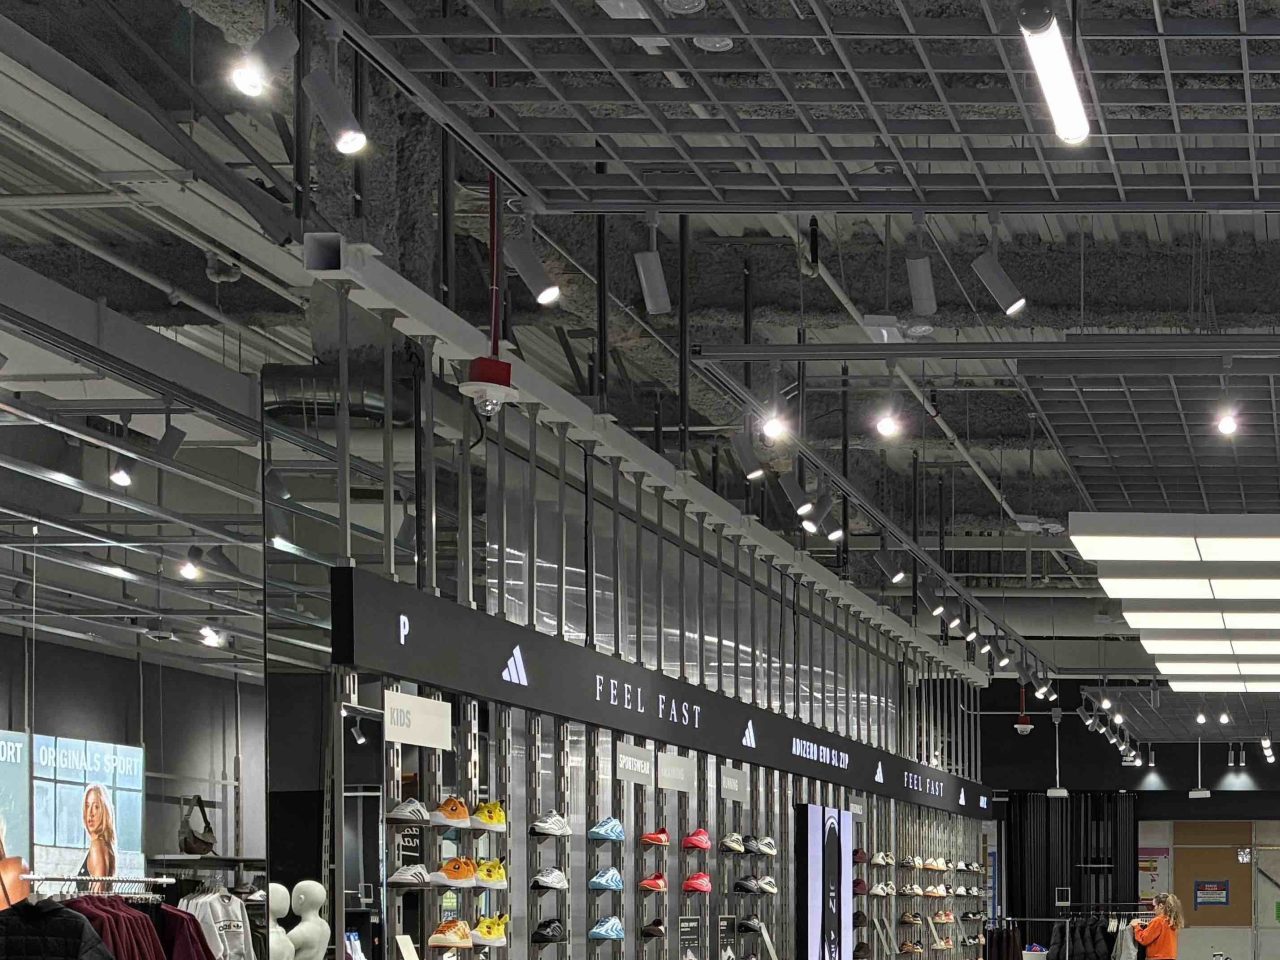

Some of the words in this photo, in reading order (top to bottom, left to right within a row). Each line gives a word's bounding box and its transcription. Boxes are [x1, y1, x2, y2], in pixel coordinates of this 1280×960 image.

[400, 614, 410, 646] P
[596, 674, 645, 713] FEEL
[658, 694, 701, 729] FAST
[390, 708, 412, 729] KIDS
[39, 744, 101, 772] ORIGINALS
[103, 754, 139, 777] SPORT
[618, 753, 651, 776] SPORTSWEAR
[792, 737, 818, 761] ADIZERO
[819, 745, 830, 765] EVO
[831, 749, 838, 767] SL
[839, 752, 849, 770] ZIP
[904, 771, 923, 792] FEEL
[926, 778, 944, 798] FAST
